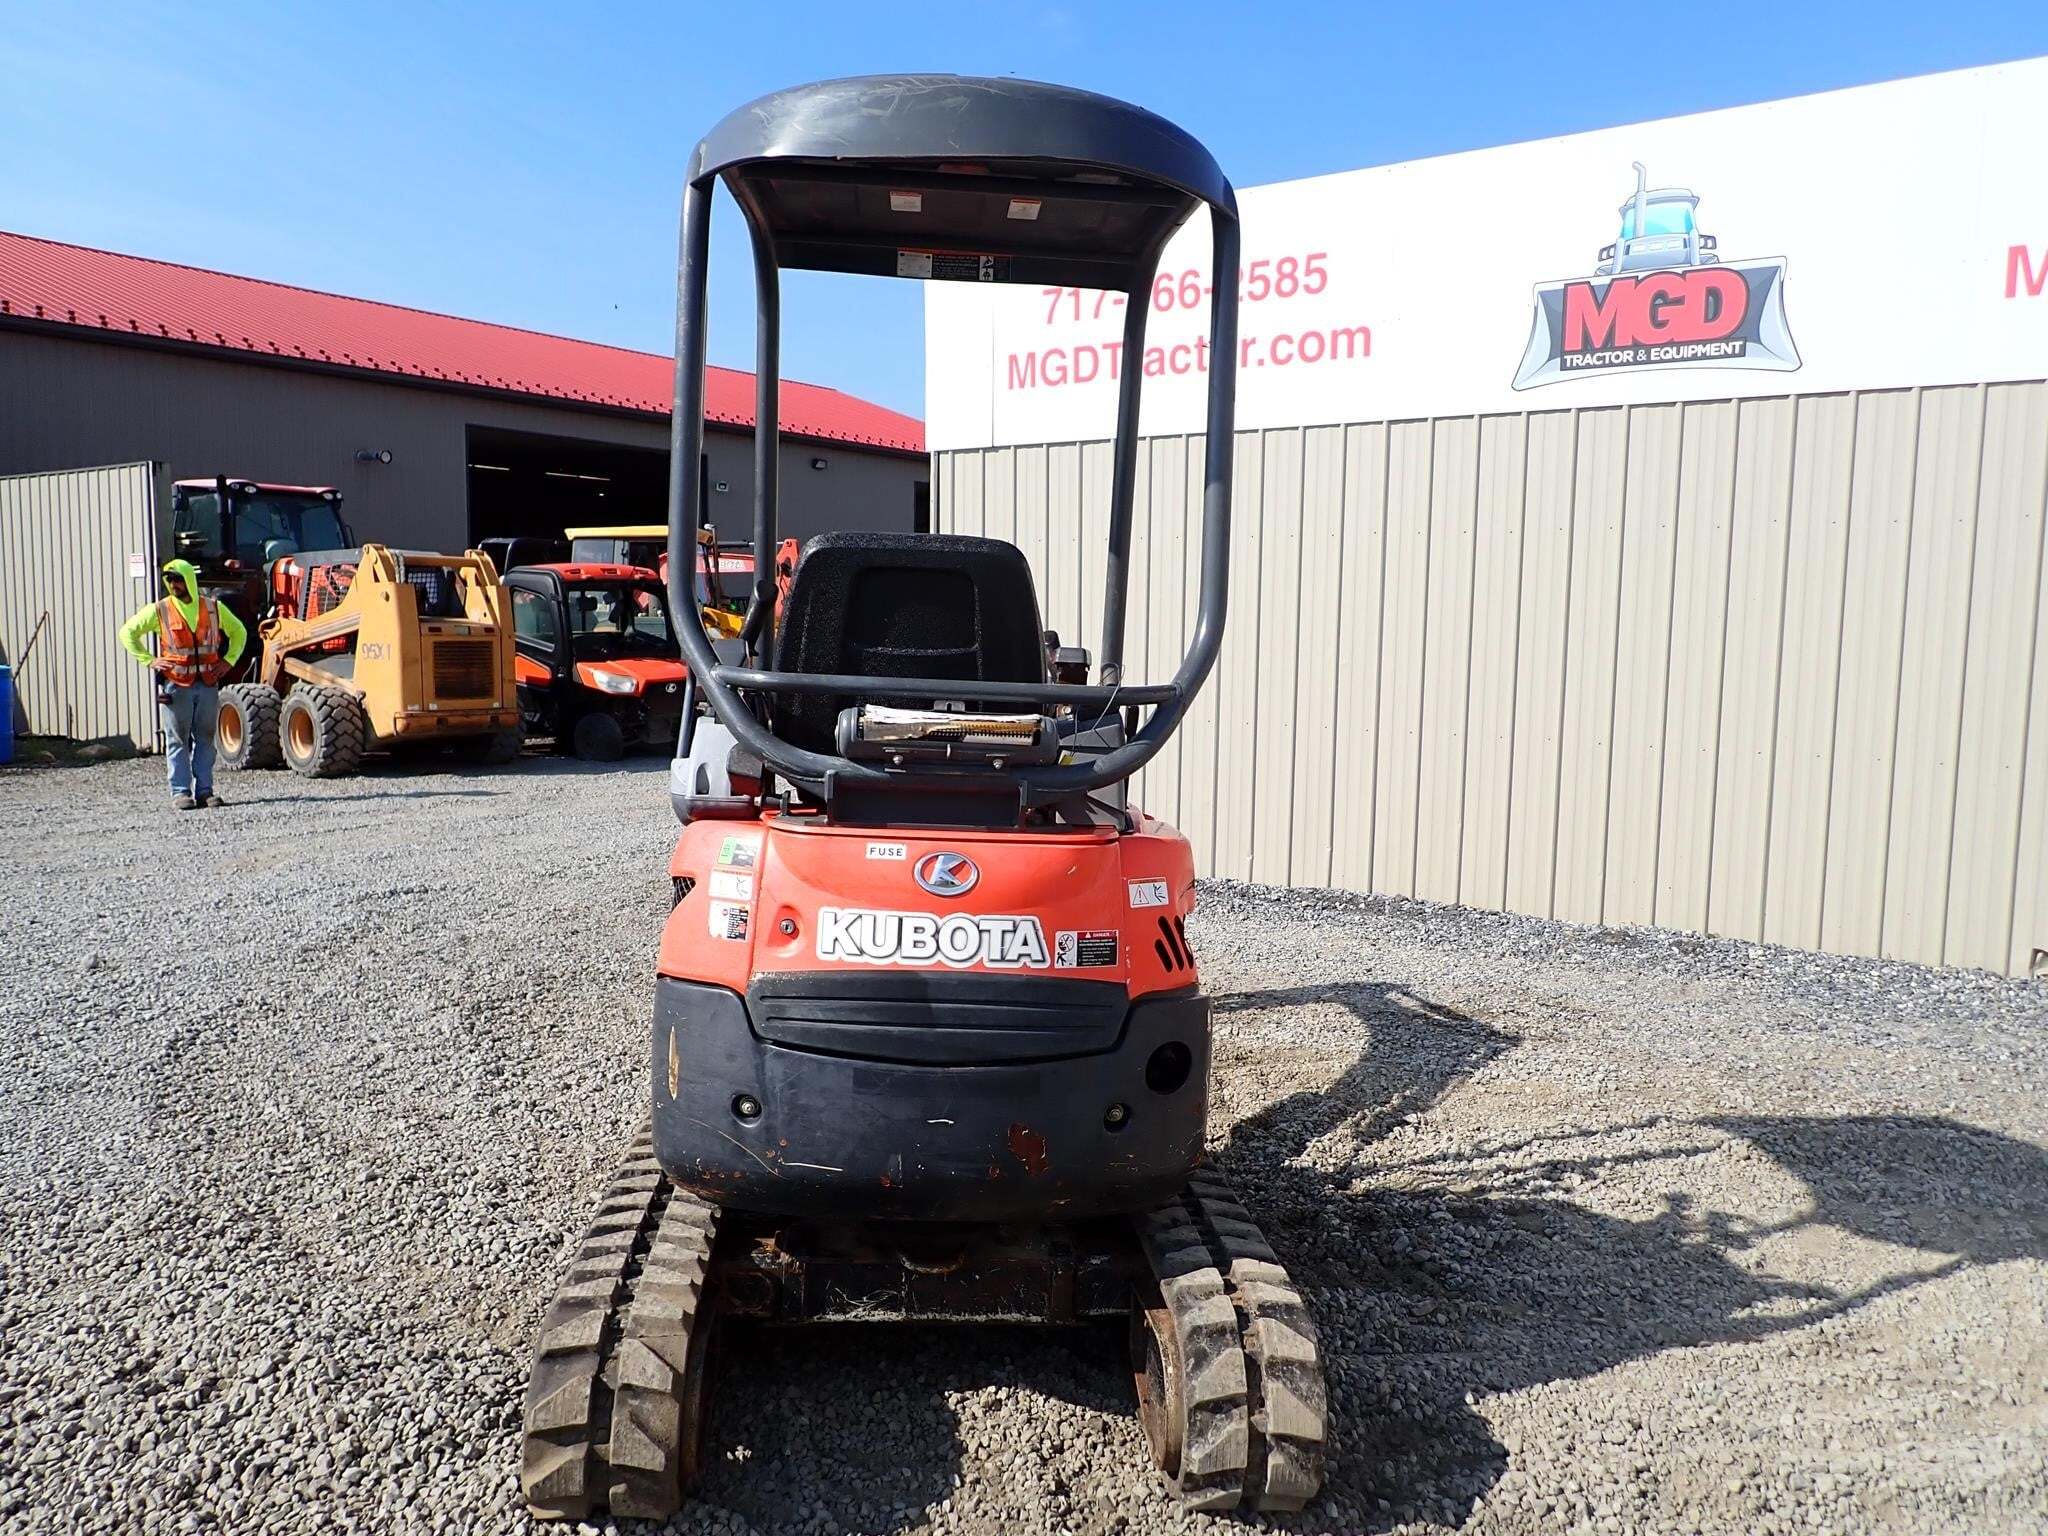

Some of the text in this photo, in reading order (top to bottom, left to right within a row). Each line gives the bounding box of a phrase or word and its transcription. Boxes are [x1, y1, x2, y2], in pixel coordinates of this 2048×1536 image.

[1042, 252, 1328, 325] 717-66-585
[1564, 268, 1748, 352] MGD
[1008, 326, 1372, 390] MGDTactr.com
[1564, 341, 1744, 368] TRACTOR & EQUIPMENT
[869, 847, 904, 857] FUSE
[820, 910, 1047, 963] KUBOTA
